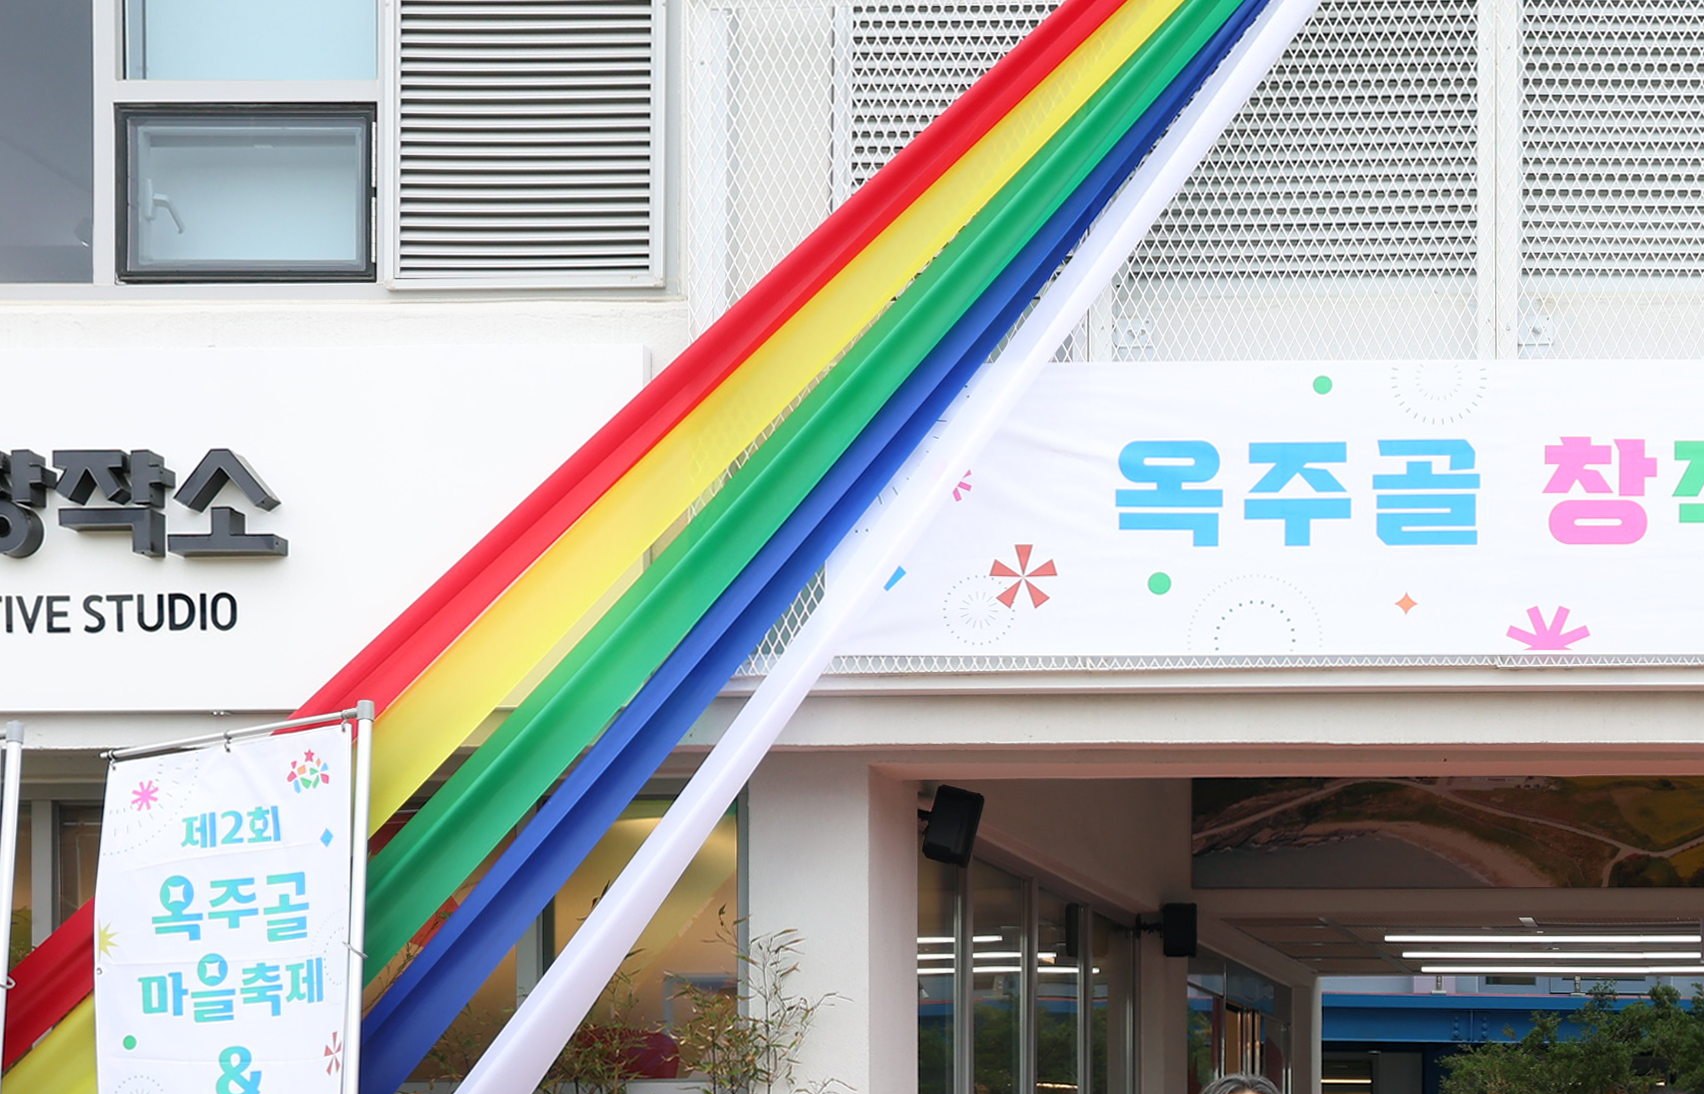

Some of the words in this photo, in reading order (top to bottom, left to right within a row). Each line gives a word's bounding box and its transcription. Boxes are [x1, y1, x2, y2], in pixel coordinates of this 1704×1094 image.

[1115, 439, 1480, 547] 옥주골
[0, 595, 71, 633] IVE
[83, 592, 238, 633] STUDIO
[181, 806, 281, 848] 제2회
[152, 872, 309, 941] 옥주골
[138, 953, 324, 1022] 마을축제
